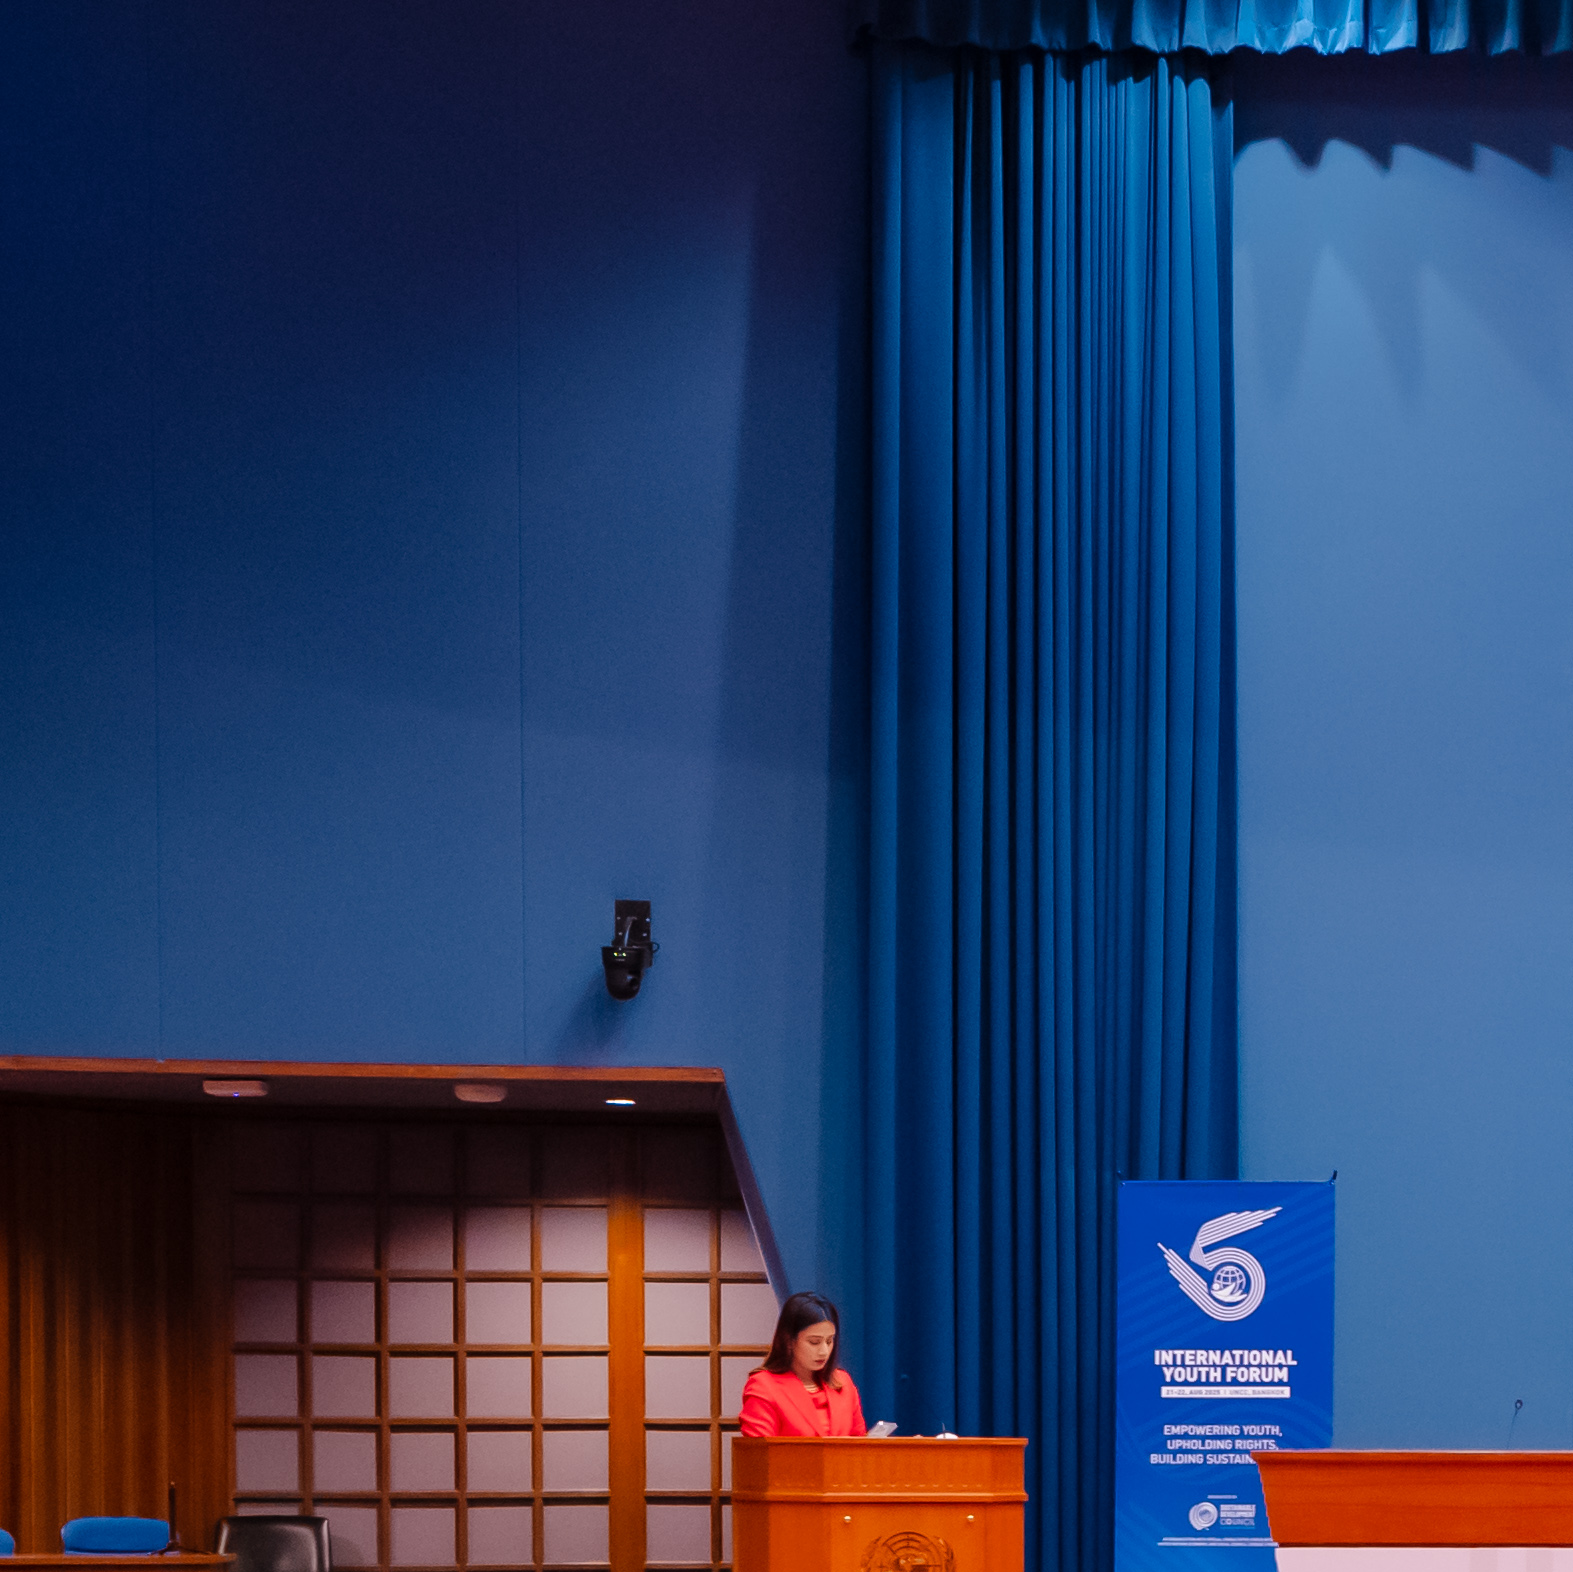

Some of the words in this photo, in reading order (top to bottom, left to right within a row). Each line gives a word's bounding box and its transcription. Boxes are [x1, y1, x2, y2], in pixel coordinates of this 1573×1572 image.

[1154, 1350, 1298, 1365] INTERNATIONAL
[1162, 1367, 1222, 1382] YOUTH
[1226, 1367, 1288, 1382] FORUM
[1163, 1425, 1240, 1435] EMPOWERING
[1242, 1425, 1283, 1437] YOUTH,
[1167, 1439, 1233, 1450] UPHOLDING
[1235, 1439, 1279, 1450] RIGHTS,
[1150, 1453, 1204, 1464] BUILDING
[1206, 1453, 1256, 1464] SUSTAIN
